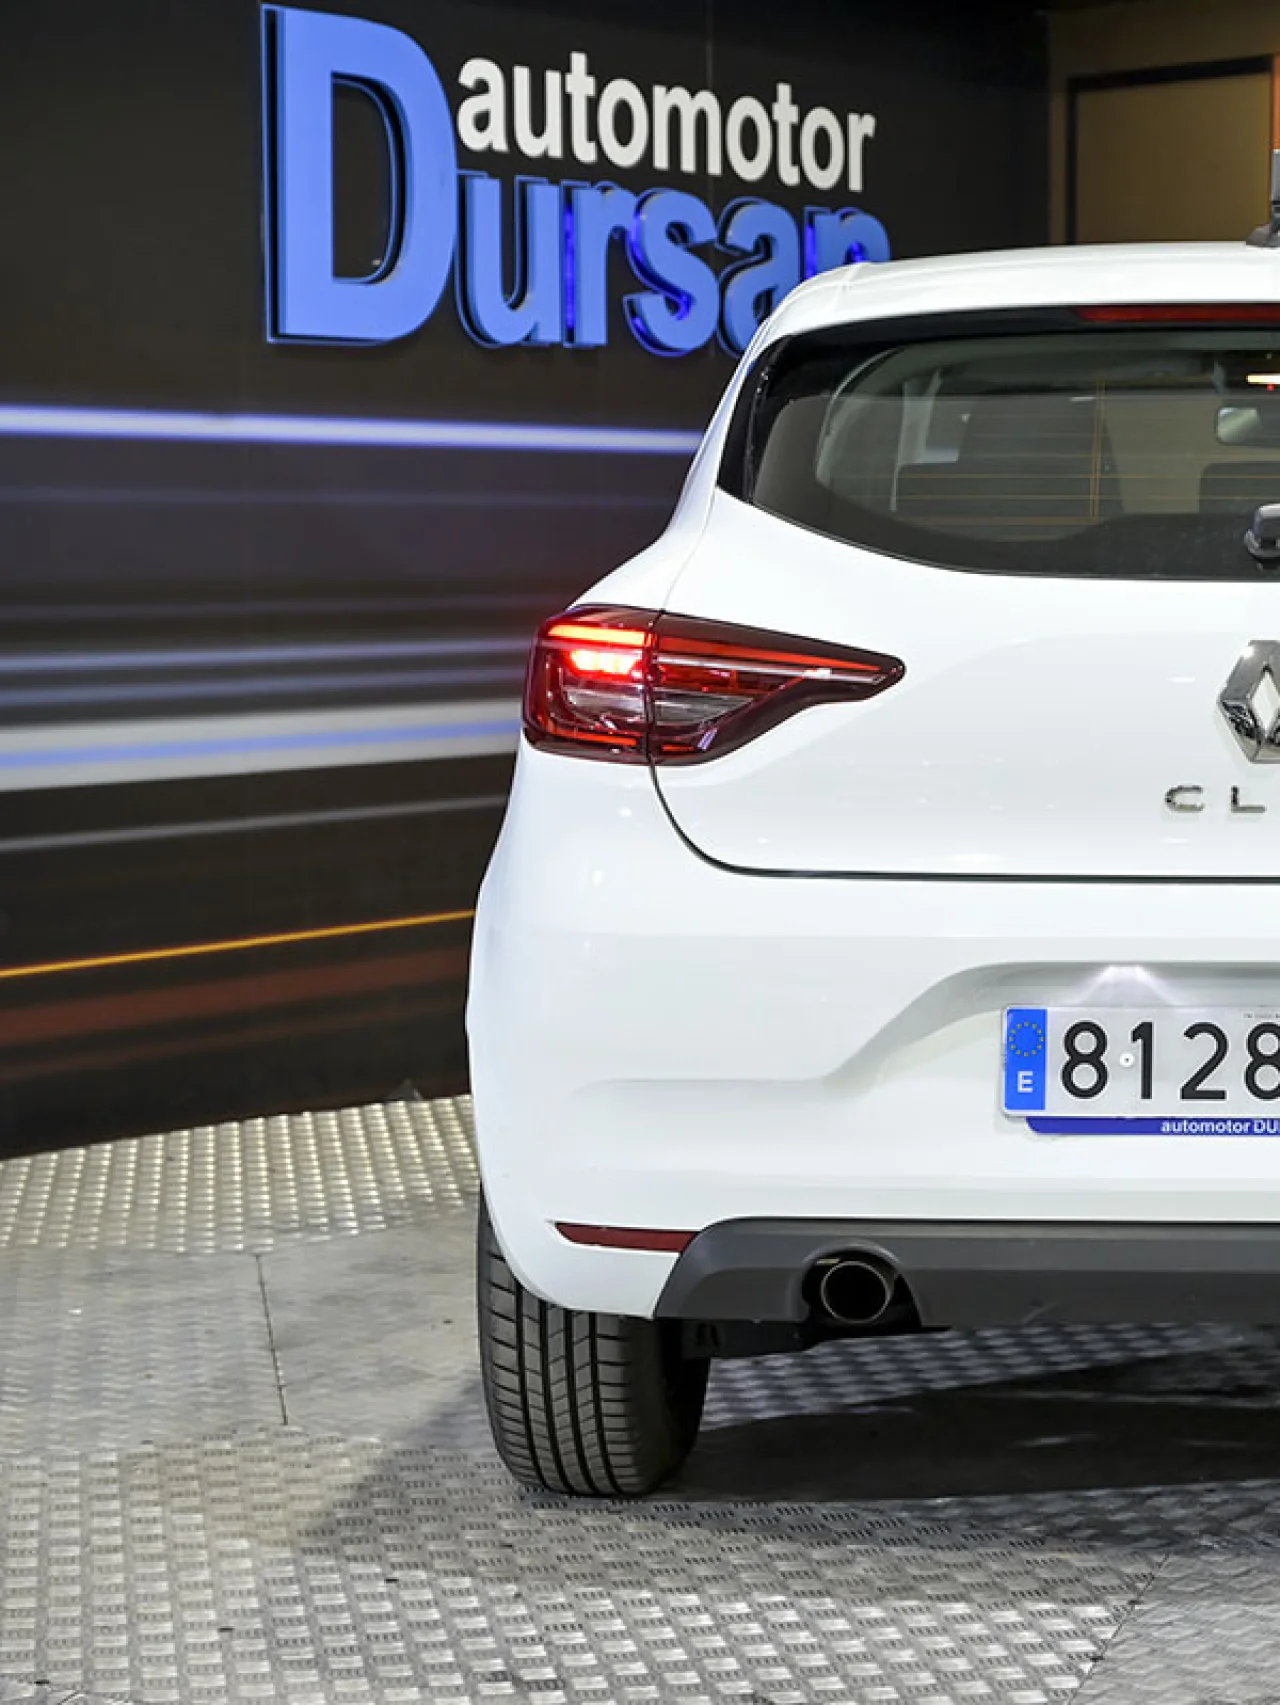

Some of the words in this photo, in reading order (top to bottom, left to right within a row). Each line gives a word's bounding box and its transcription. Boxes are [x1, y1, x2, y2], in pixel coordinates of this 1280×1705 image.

[457, 52, 876, 191] automotor
[1017, 1070, 1034, 1093] E
[1161, 1120, 1250, 1133] automotor
